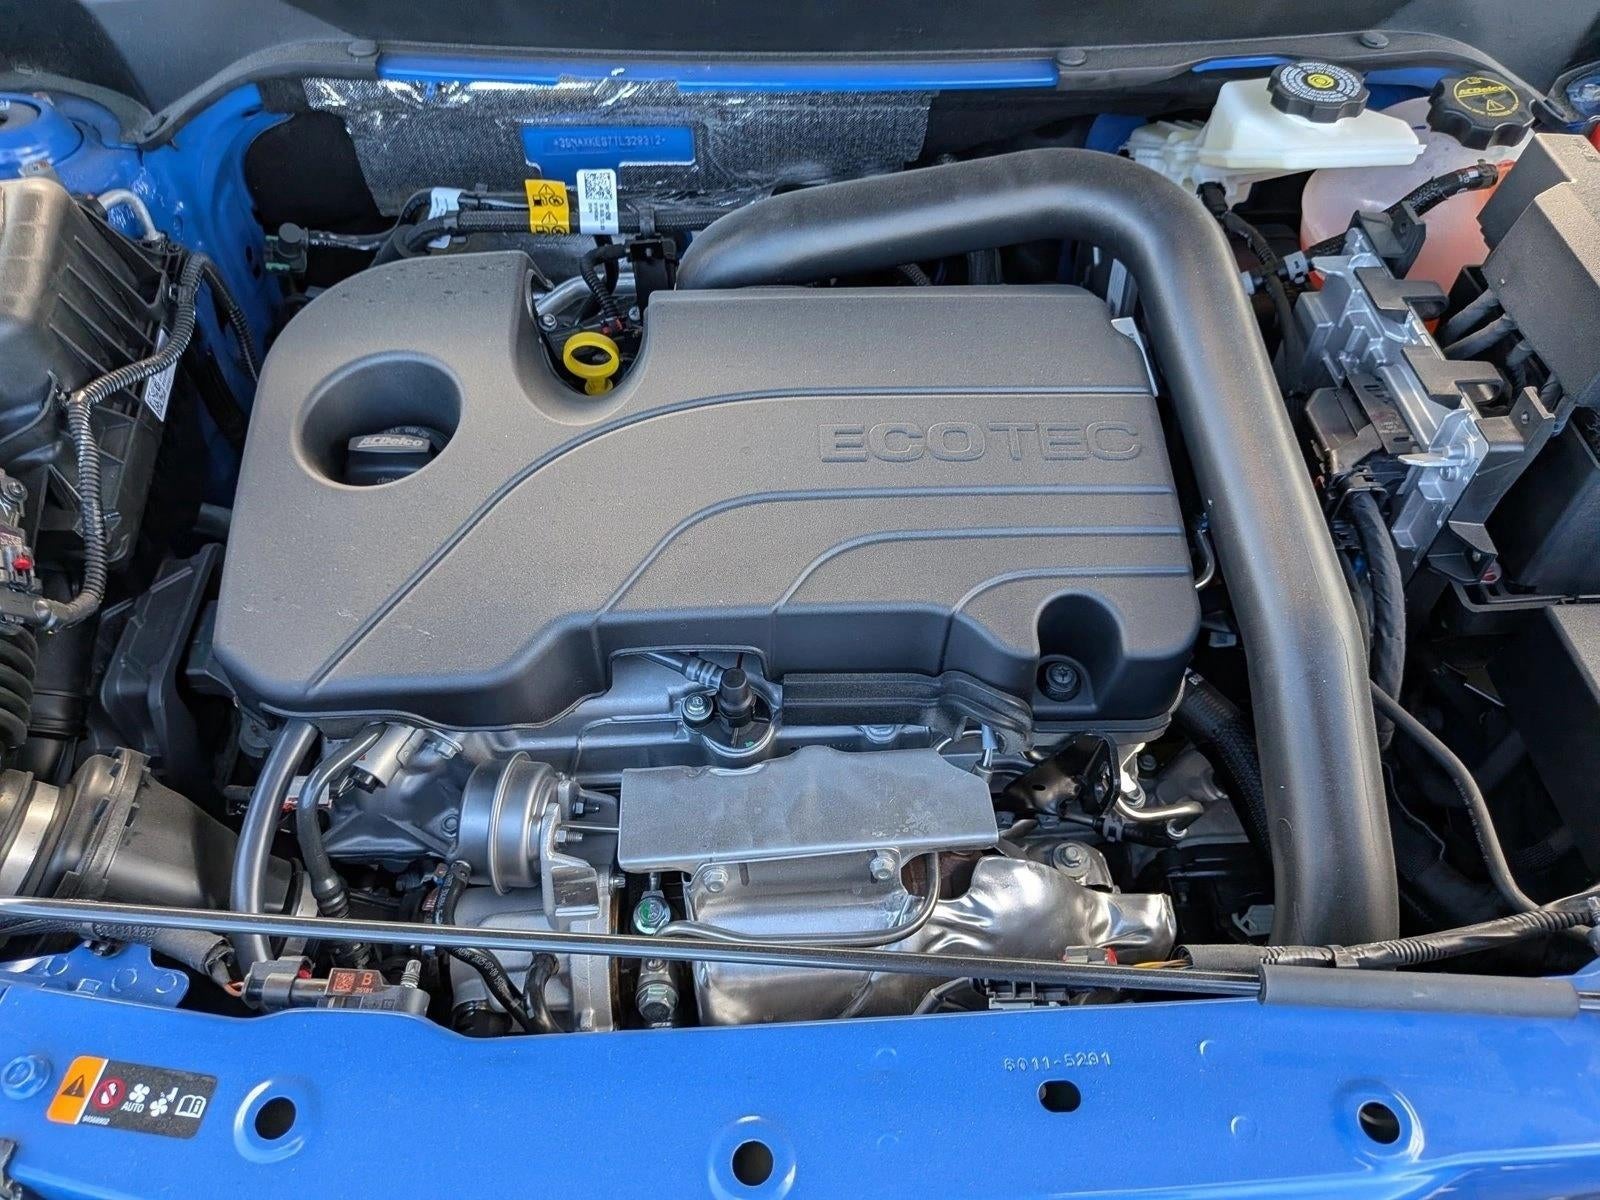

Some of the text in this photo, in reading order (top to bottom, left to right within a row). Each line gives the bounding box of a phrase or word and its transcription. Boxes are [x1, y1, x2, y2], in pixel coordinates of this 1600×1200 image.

[357, 436, 424, 448] ACDelco
[818, 421, 1141, 462] ECOTEC
[362, 972, 373, 985] B
[120, 1101, 145, 1113] AUTO
